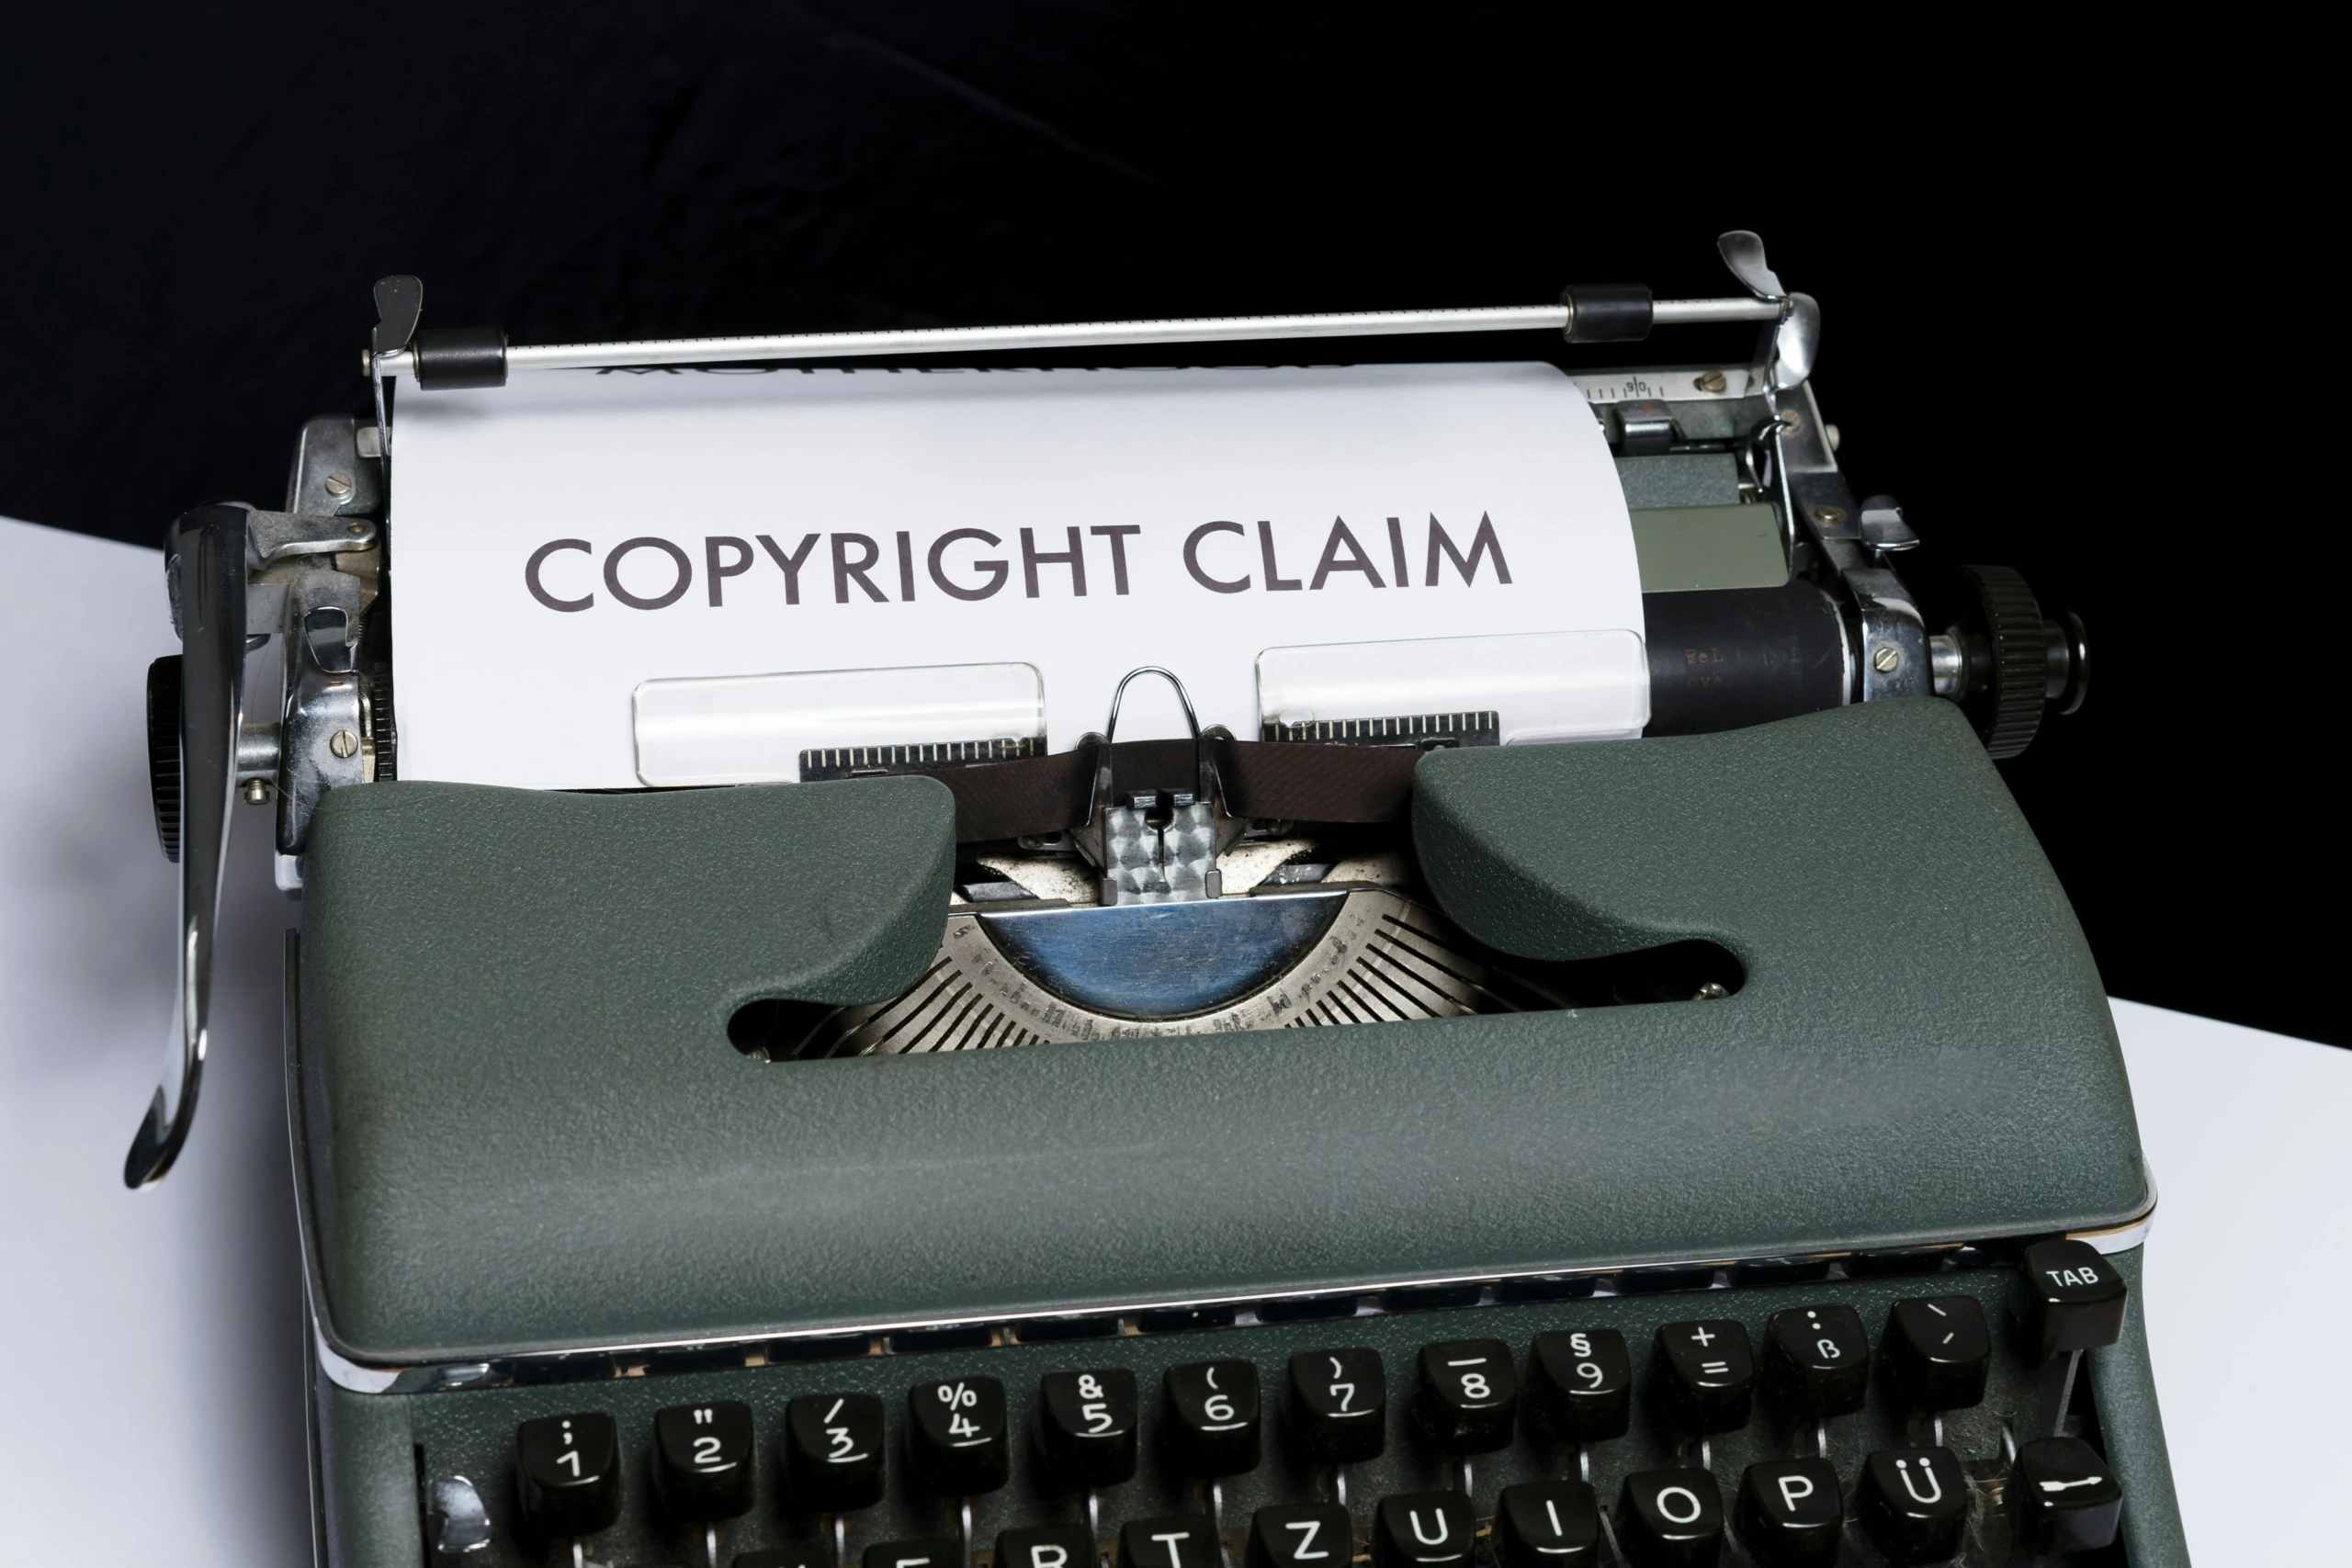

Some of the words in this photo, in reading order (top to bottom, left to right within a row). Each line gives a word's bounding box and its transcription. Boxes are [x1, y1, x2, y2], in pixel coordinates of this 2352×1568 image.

[525, 525, 1141, 613] COPYRIGHT
[1182, 511, 1512, 595] CLAIM
[2046, 1266, 2098, 1287] TAB
[1569, 1332, 1592, 1359] §
[1690, 1326, 1715, 1348] +
[1205, 1366, 1218, 1390] (
[1329, 1357, 1342, 1380] )
[1575, 1362, 1603, 1389] 9
[937, 1382, 978, 1411] %
[1078, 1373, 1104, 1400] &
[1329, 1382, 1355, 1413] 7
[1460, 1372, 1491, 1399] 8
[693, 1408, 713, 1424] "
[823, 1398, 844, 1424] /
[1080, 1403, 1114, 1434] 5
[1204, 1394, 1235, 1421] 6
[948, 1413, 980, 1438] 4
[693, 1437, 722, 1464] 2
[825, 1427, 855, 1460] 3
[556, 1450, 581, 1477] 1
[1778, 1475, 1815, 1513] P
[1894, 1457, 1942, 1504] Ü
[1544, 1499, 1564, 1537] I
[1657, 1486, 1702, 1525] O
[1408, 1507, 1449, 1546] U
[1151, 1530, 1191, 1568] T
[1284, 1520, 1329, 1561] Z
[1030, 1544, 1069, 1568] R
